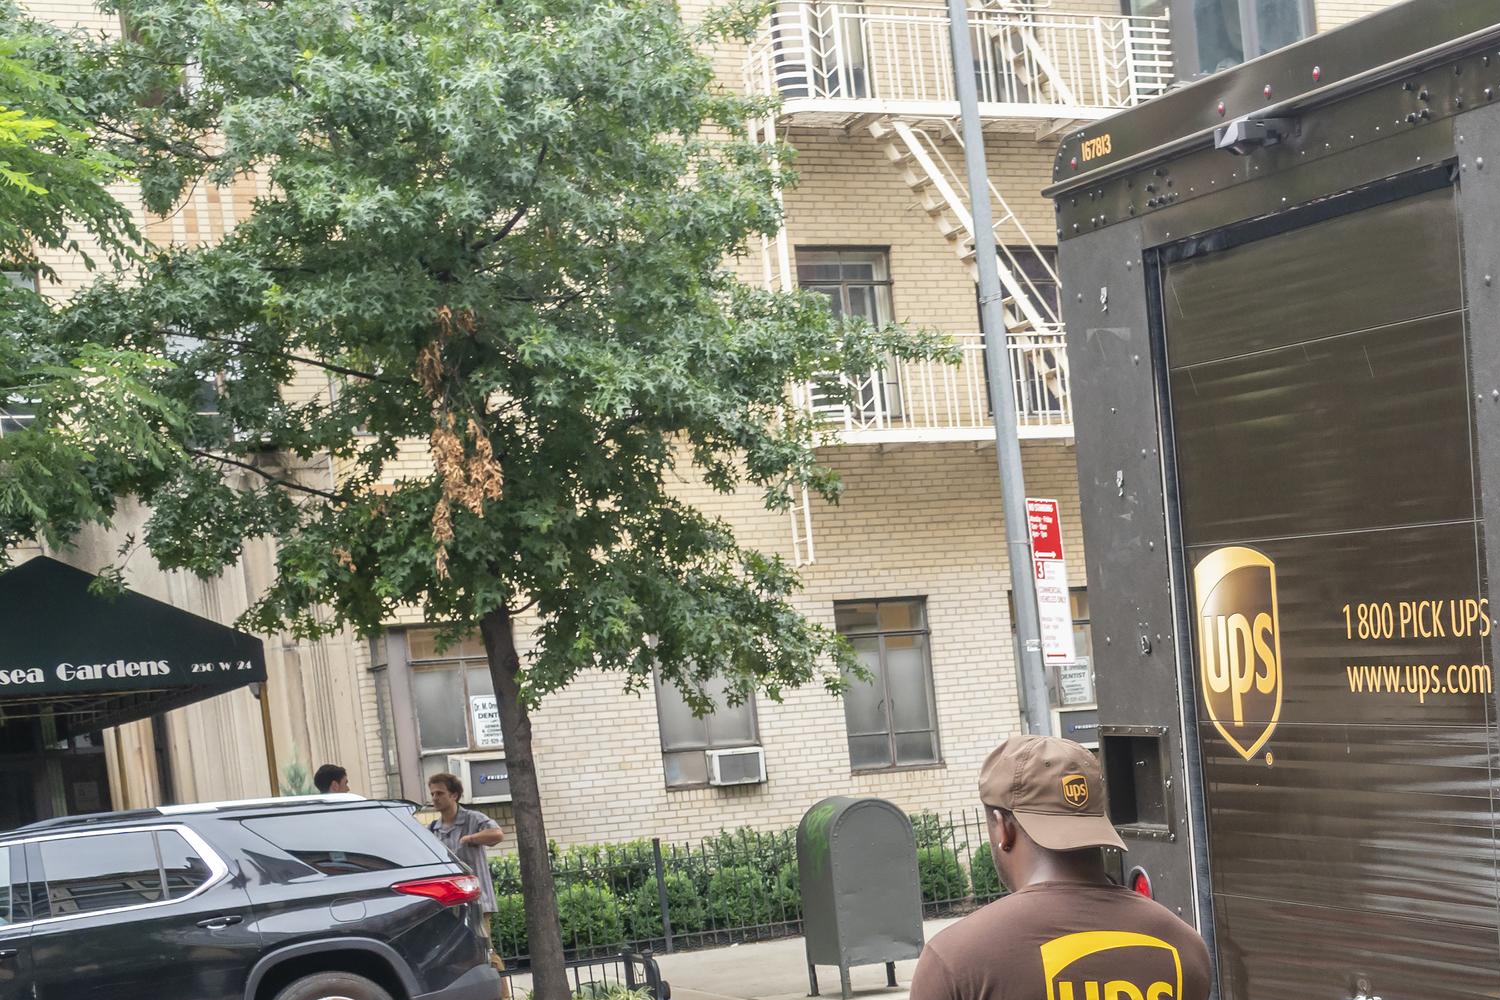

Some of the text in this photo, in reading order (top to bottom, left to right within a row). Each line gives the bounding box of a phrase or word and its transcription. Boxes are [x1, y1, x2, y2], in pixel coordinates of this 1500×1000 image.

[1081, 133, 1112, 162] 167813
[1036, 561, 1044, 579] 3
[1342, 598, 1491, 640] 1 800 PICK UPS
[55, 659, 171, 683] Gardens
[218, 661, 232, 671] W
[1203, 612, 1277, 727] ups
[1346, 663, 1493, 704] www.ups.com
[1065, 783, 1087, 802] ups
